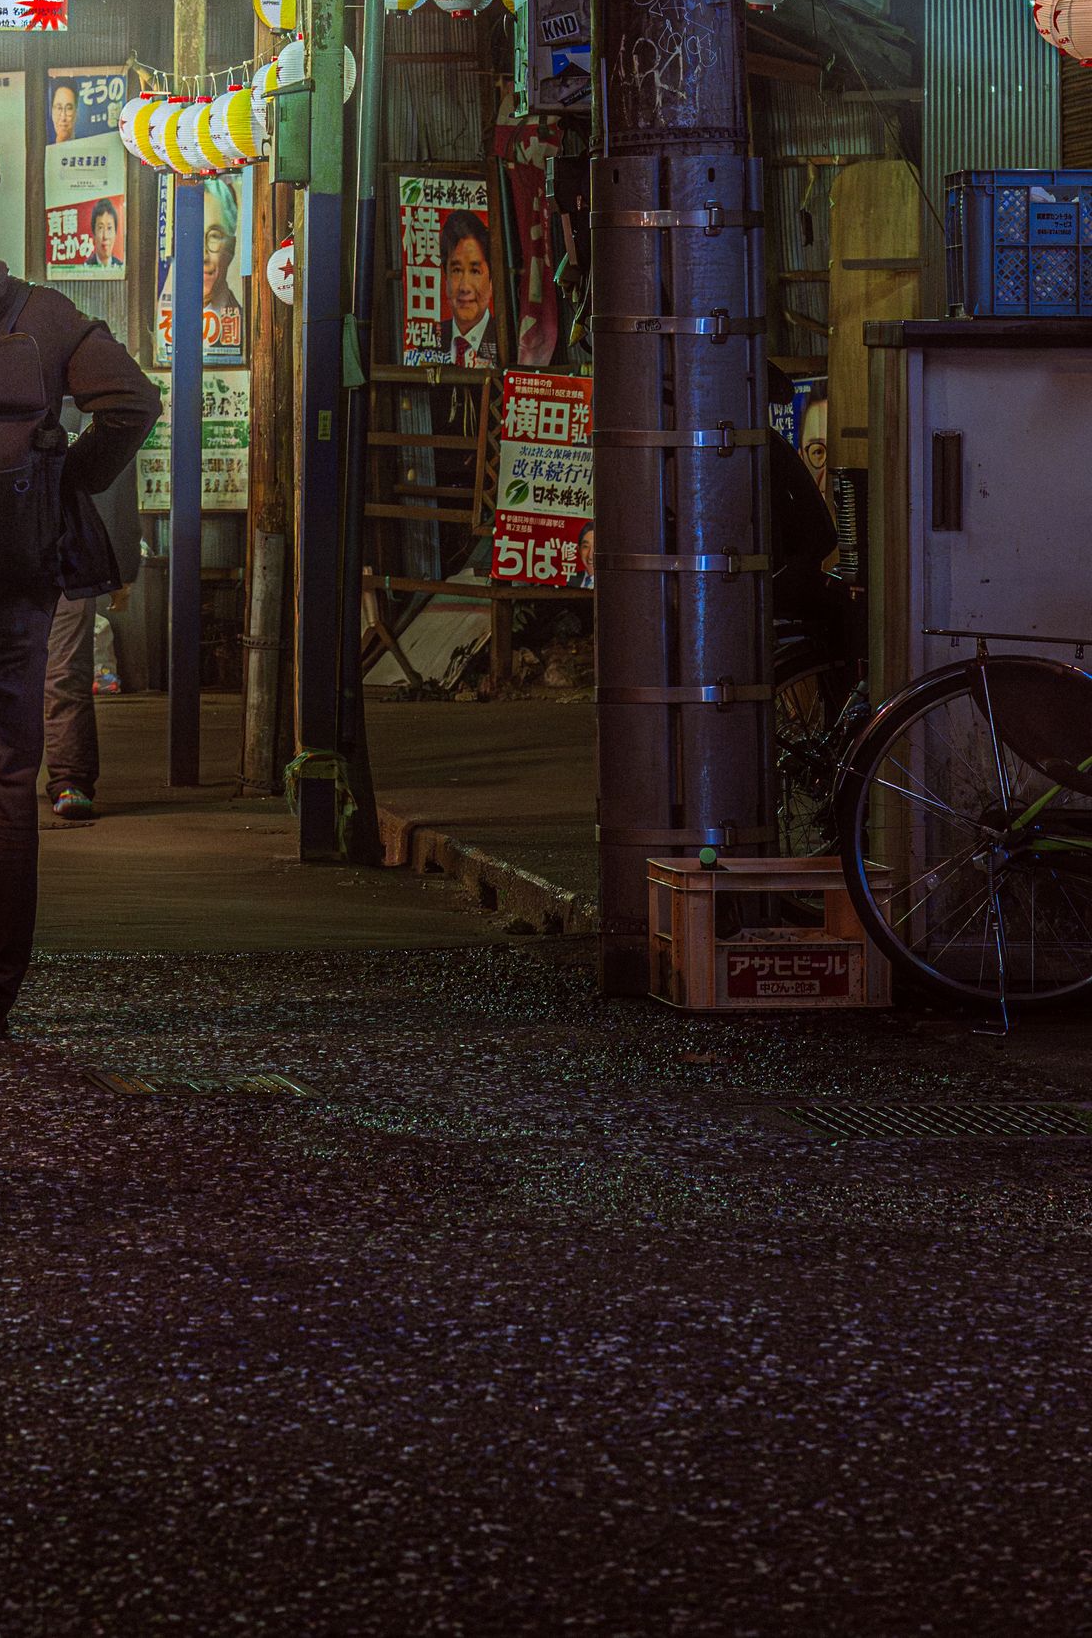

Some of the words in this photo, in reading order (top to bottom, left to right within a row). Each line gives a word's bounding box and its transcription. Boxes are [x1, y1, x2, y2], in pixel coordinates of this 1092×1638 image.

[541, 14, 578, 41] KND
[79, 76, 125, 107] そうの
[422, 181, 488, 210] 日本維新の会
[50, 233, 96, 262] たかみ
[402, 207, 443, 322] 横田
[158, 309, 242, 347] その創
[406, 322, 438, 348] 光弘
[505, 396, 571, 442] 横田
[571, 402, 590, 445] 光弘
[520, 445, 593, 462] 次は社会保険料削
[494, 534, 562, 580] ちば
[561, 540, 578, 583] 修平
[728, 955, 848, 977] アサヒビール
